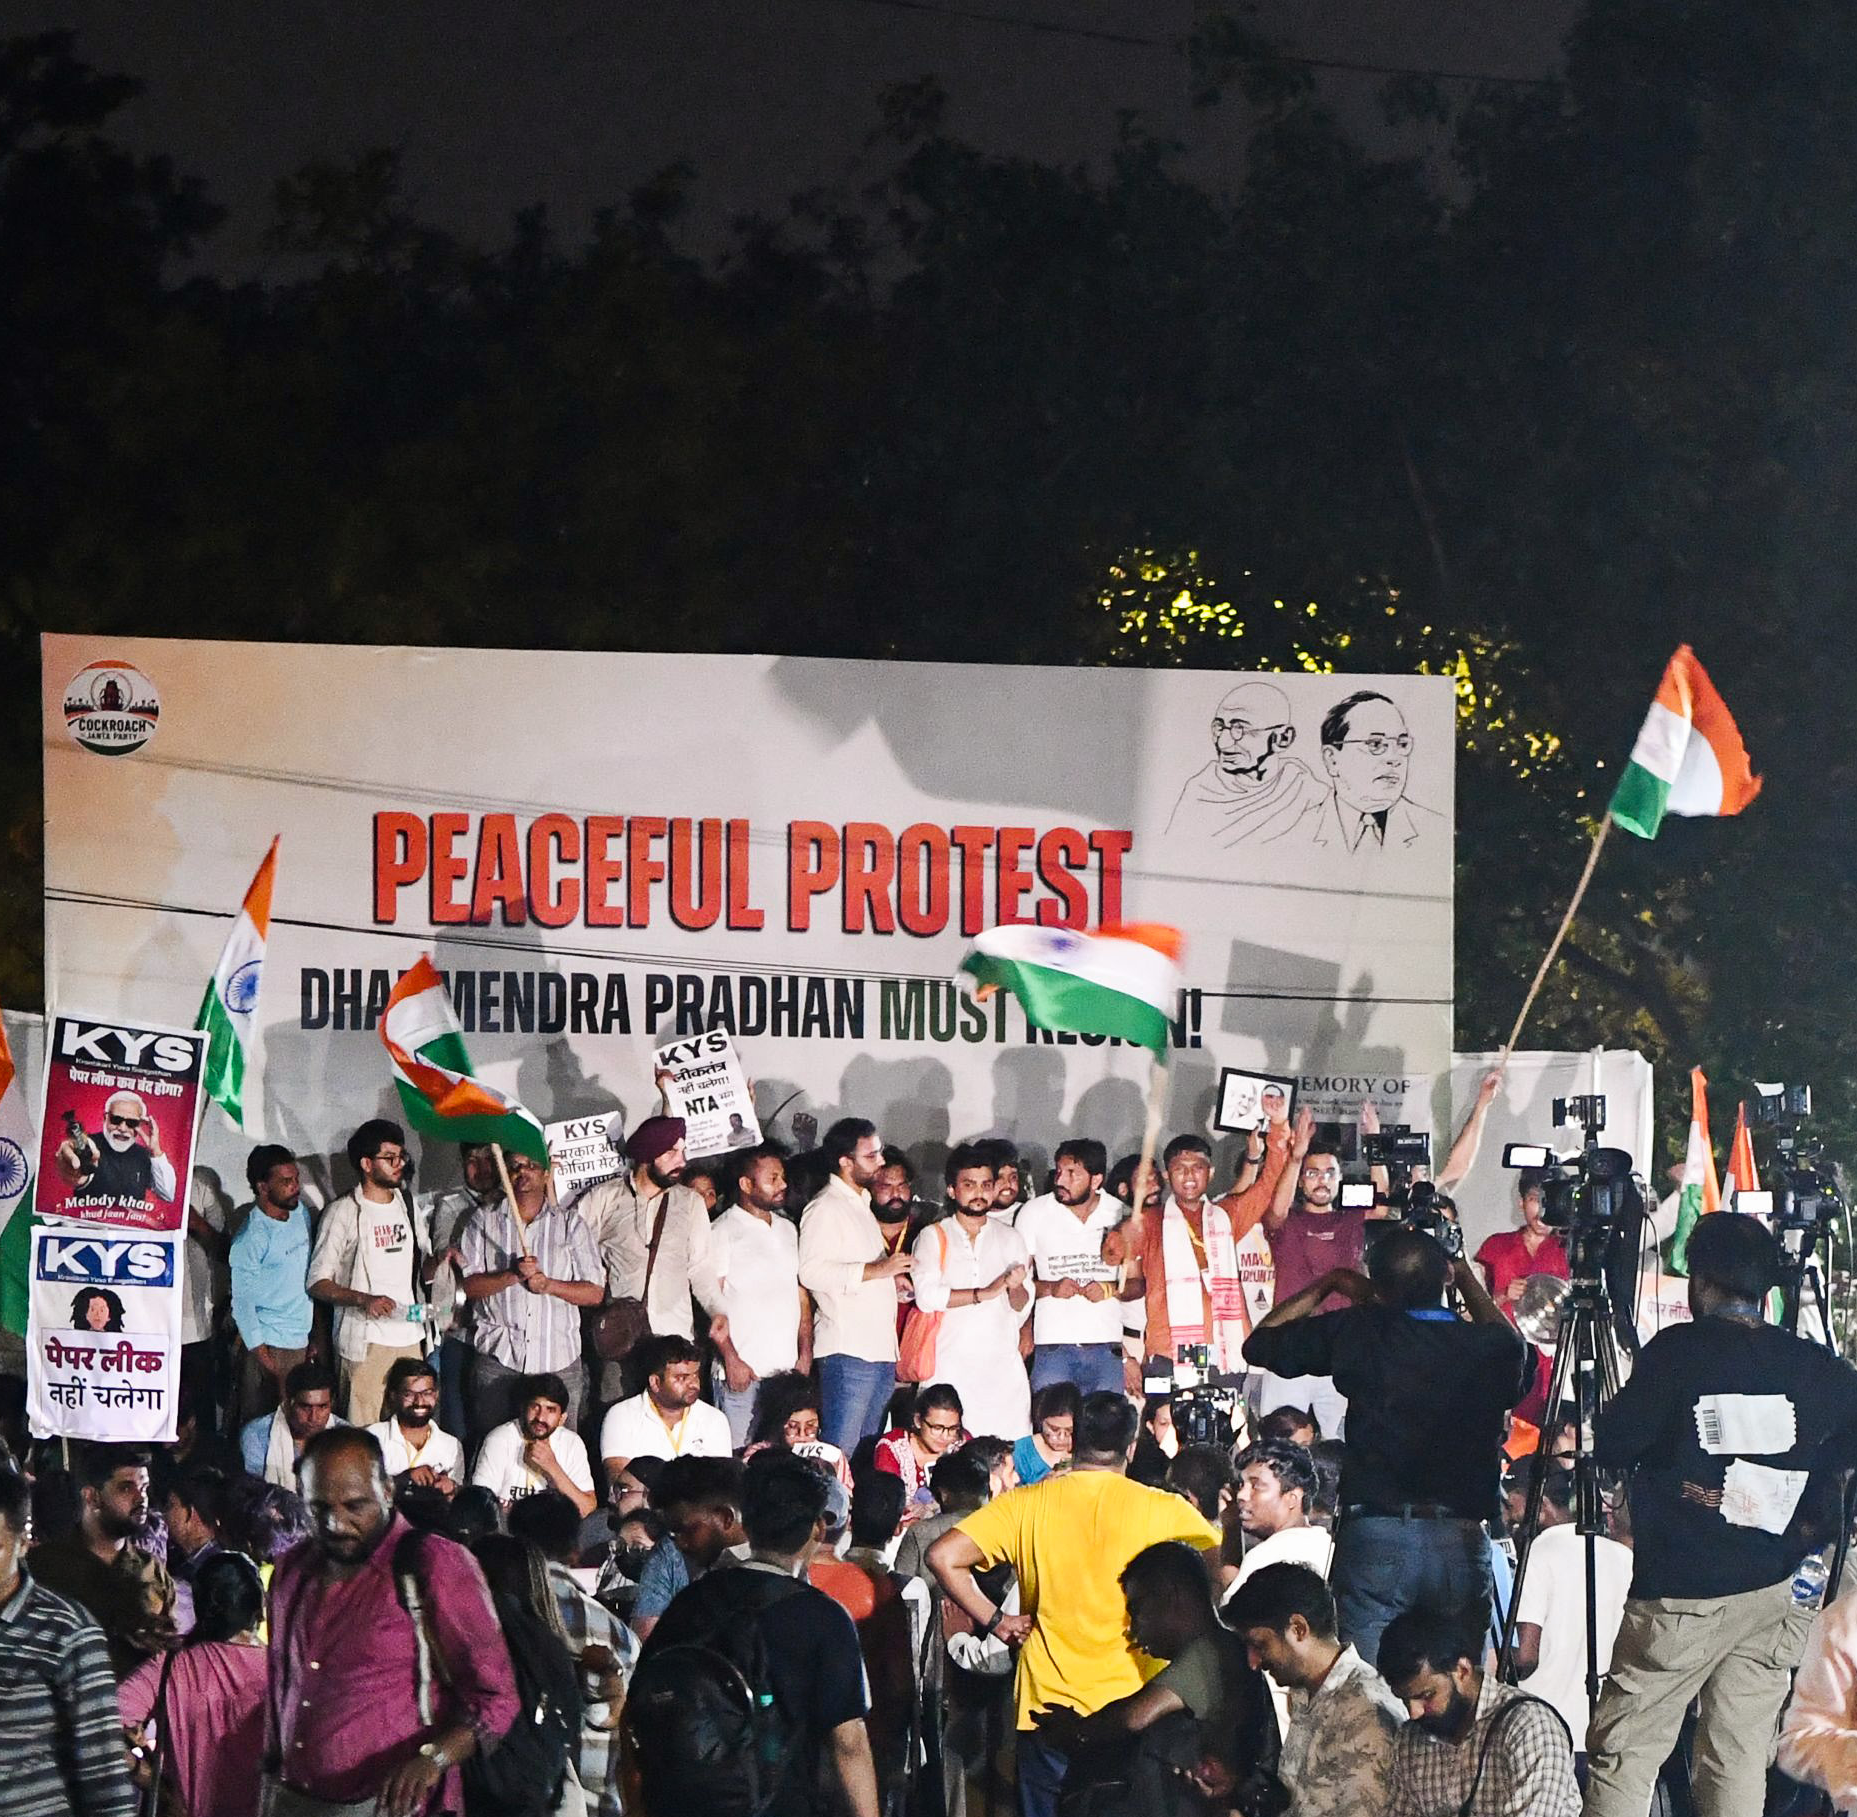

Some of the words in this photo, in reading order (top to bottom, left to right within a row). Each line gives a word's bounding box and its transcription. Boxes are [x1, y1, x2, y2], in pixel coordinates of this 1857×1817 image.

[79, 719, 146, 732] COCKROACH
[374, 811, 765, 931] PEACEFUL
[787, 820, 1132, 938] PROTEST
[301, 968, 631, 1034] DHAMENDRA
[645, 974, 864, 1039] PRADHAN
[61, 1021, 194, 1072] KYS
[659, 1033, 727, 1066] KYS
[69, 1066, 90, 1083] पेपर
[91, 1070, 116, 1087] लीक
[1296, 1076, 1376, 1094] EMORY
[1383, 1077, 1411, 1094] OF
[685, 1095, 719, 1117] NTA
[564, 1119, 606, 1139] KYS
[65, 1194, 116, 1209] Melody
[118, 1195, 154, 1212] khao
[80, 1209, 104, 1219] khud
[45, 1239, 166, 1279] KYS
[45, 1336, 96, 1371] पेपर
[99, 1340, 164, 1373] लीक
[48, 1376, 87, 1409] नहीं
[91, 1379, 164, 1410] चलेगा
